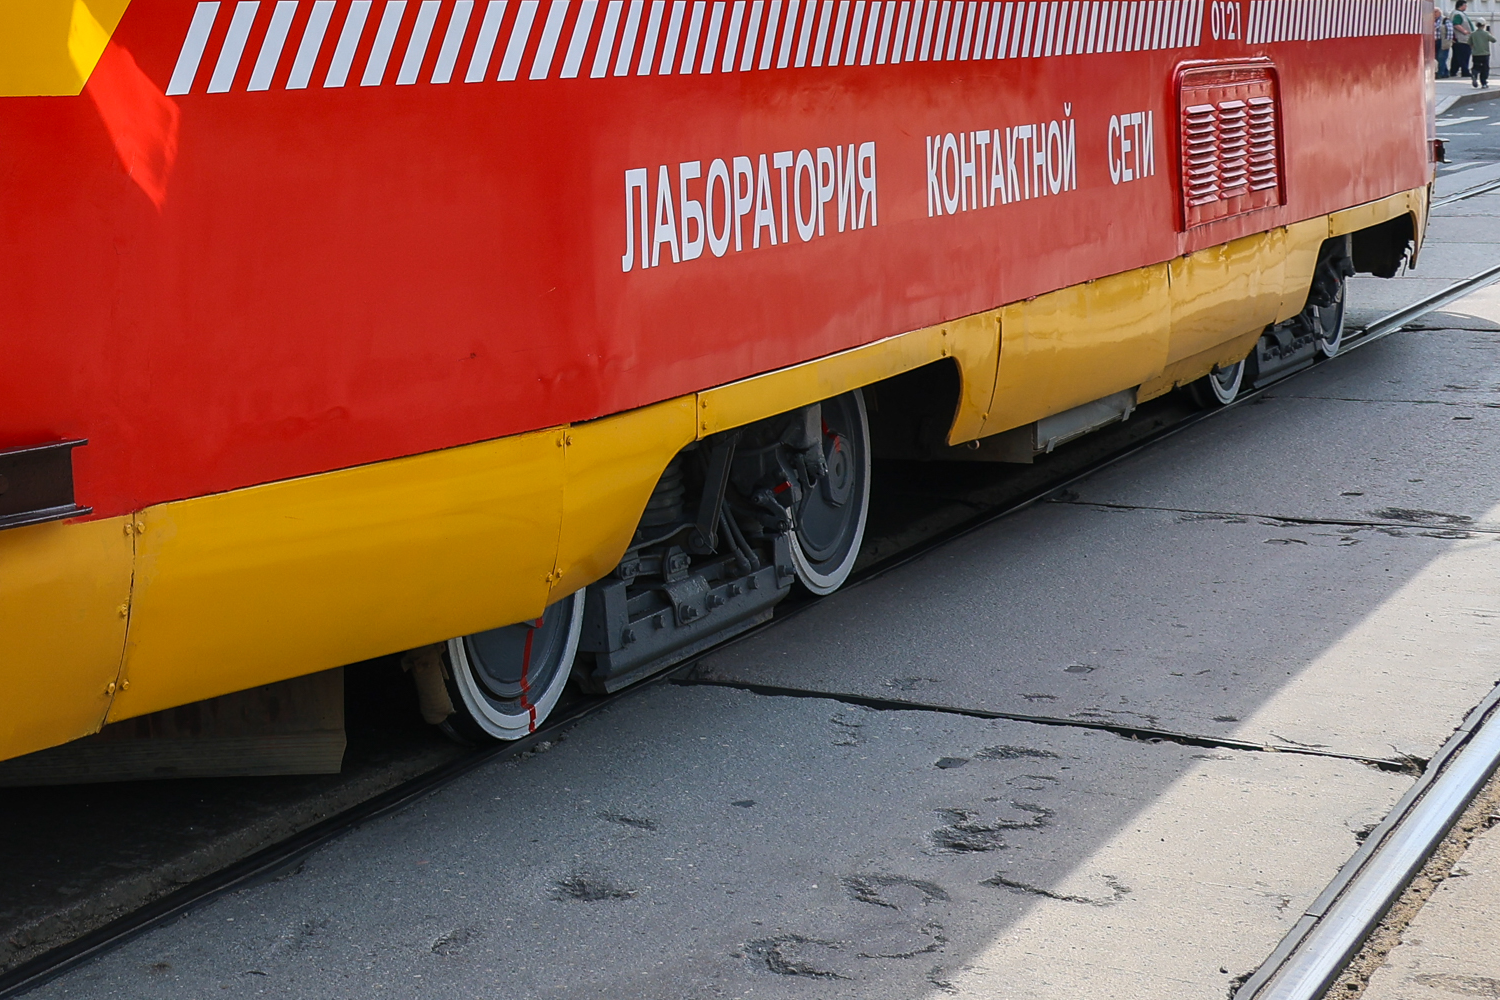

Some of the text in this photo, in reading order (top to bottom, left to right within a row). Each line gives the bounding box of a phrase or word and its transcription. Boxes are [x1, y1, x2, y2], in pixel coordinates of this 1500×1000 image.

[1211, 0, 1241, 41] 0121
[621, 101, 1155, 273] ЛАБОРАТОРИЯ КОНТАКТНОЙ СЕТИ
